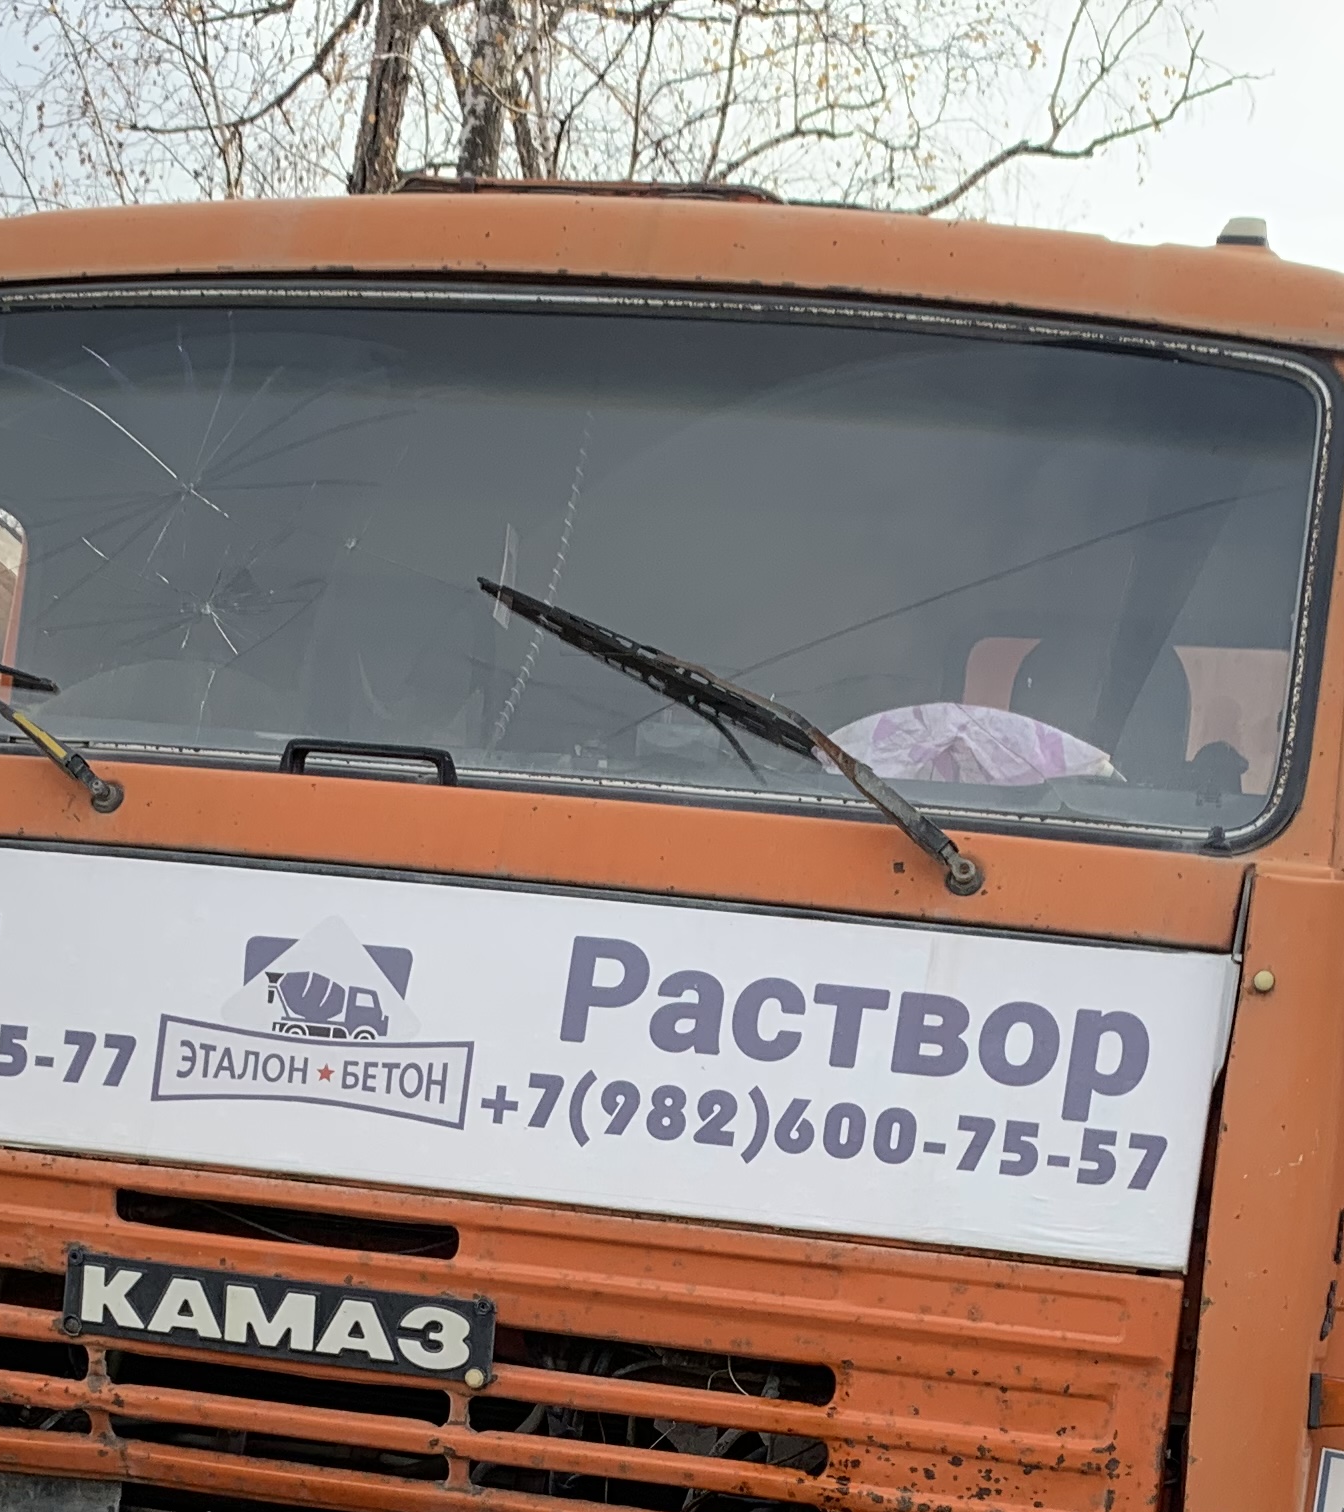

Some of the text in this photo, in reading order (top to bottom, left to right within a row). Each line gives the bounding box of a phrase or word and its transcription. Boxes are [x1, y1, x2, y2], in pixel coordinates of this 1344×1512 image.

[175, 1039, 449, 1105] ЭТАЛОН БЕТОН
[559, 935, 1151, 1122] Раствор
[480, 1069, 1168, 1191] +7(982)600-75-57
[81, 1264, 471, 1371] КАМАЗ
